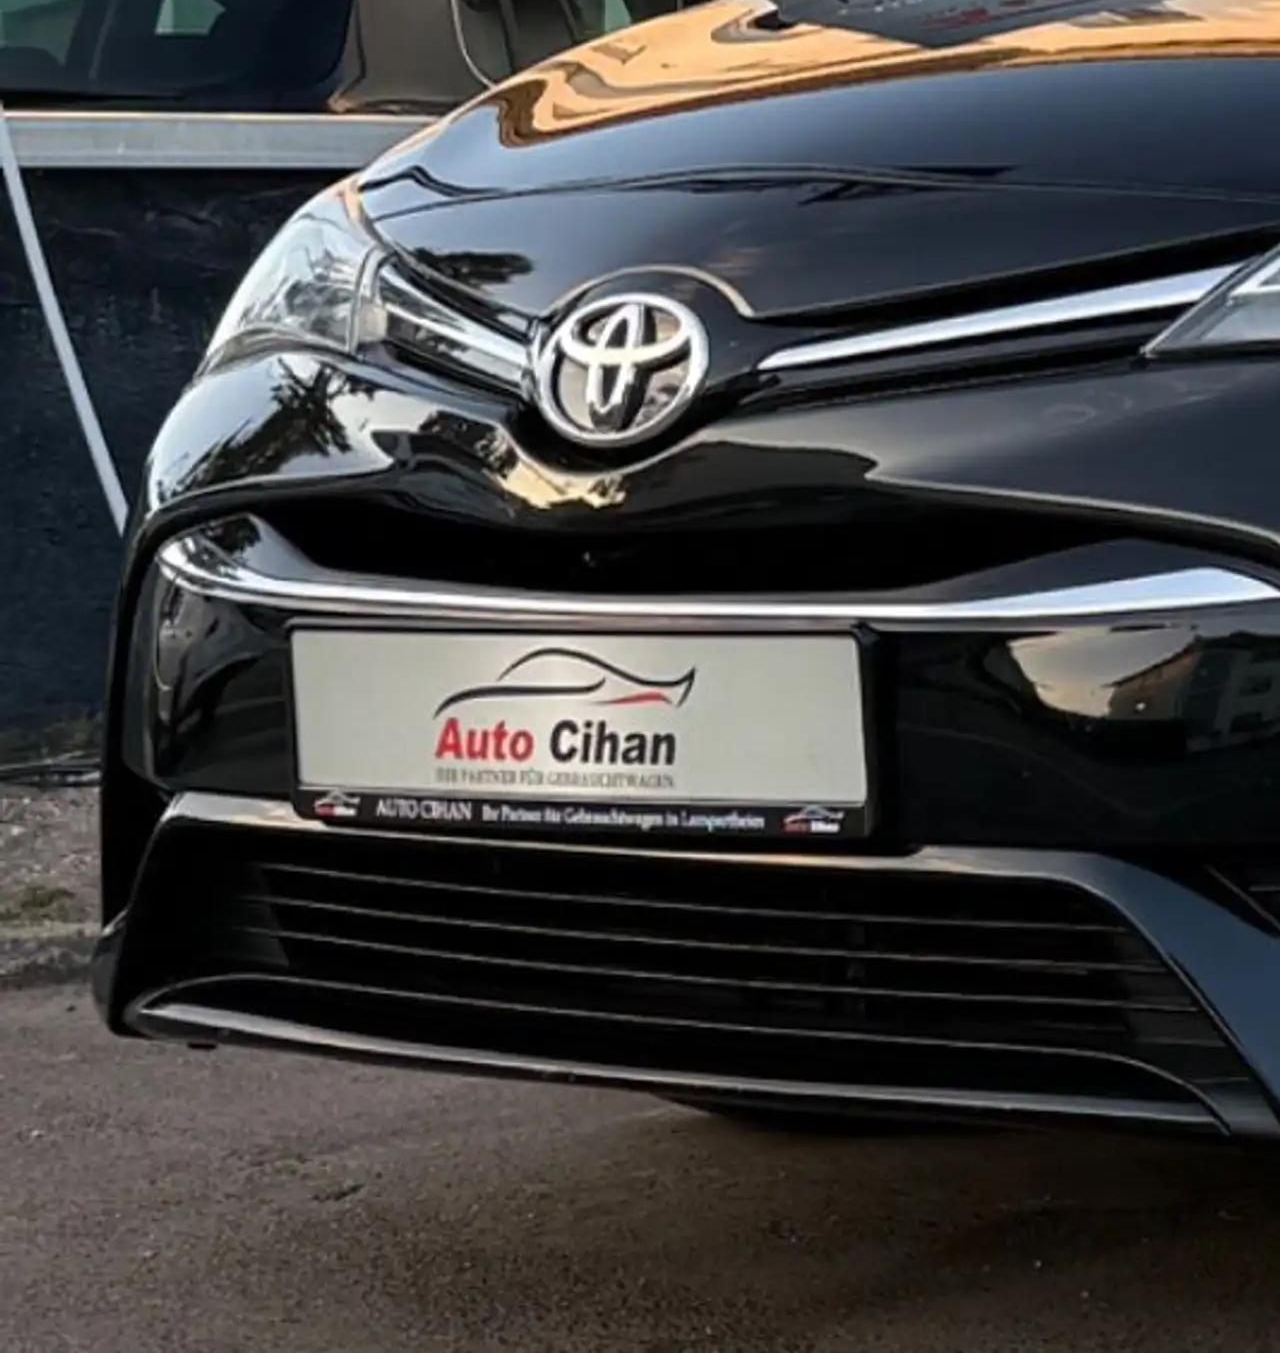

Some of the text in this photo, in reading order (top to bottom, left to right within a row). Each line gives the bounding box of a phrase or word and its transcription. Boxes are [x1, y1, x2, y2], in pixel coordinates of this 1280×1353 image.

[434, 717, 677, 766] Auto Cihan
[376, 798, 419, 819] AUTO
